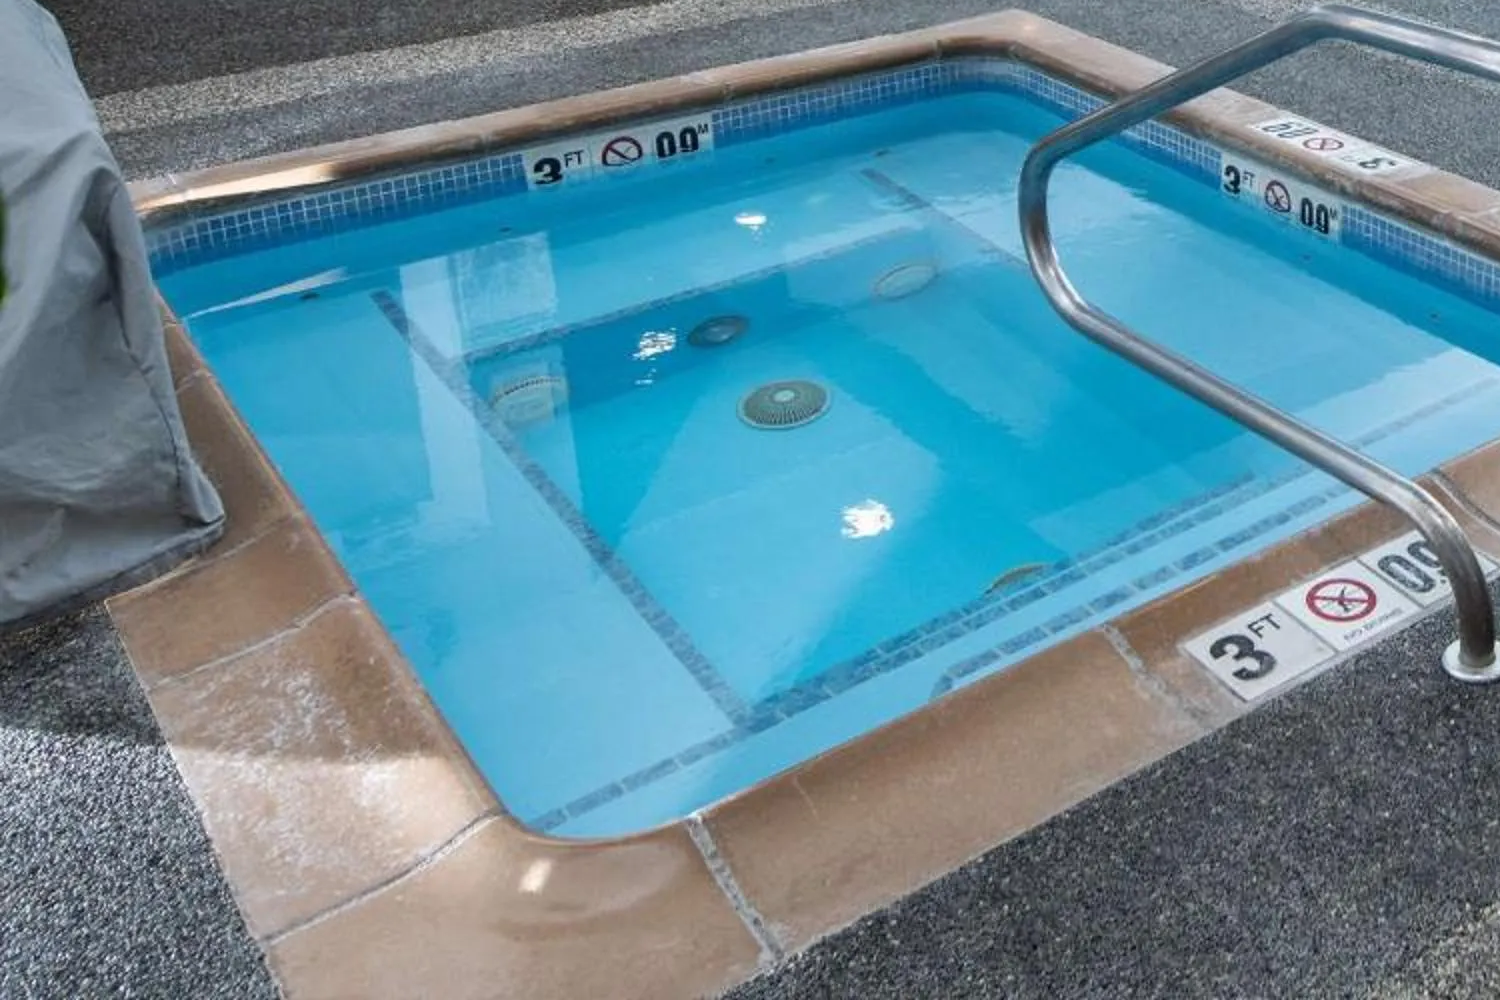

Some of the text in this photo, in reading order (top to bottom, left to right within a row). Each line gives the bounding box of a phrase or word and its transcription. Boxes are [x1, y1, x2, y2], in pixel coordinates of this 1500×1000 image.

[533, 157, 563, 185] 3
[564, 149, 585, 168] FT
[698, 123, 709, 134] M
[1223, 165, 1241, 195] 3
[1242, 170, 1256, 188] FT
[1210, 634, 1277, 680] 3
[1247, 613, 1281, 638] FT
